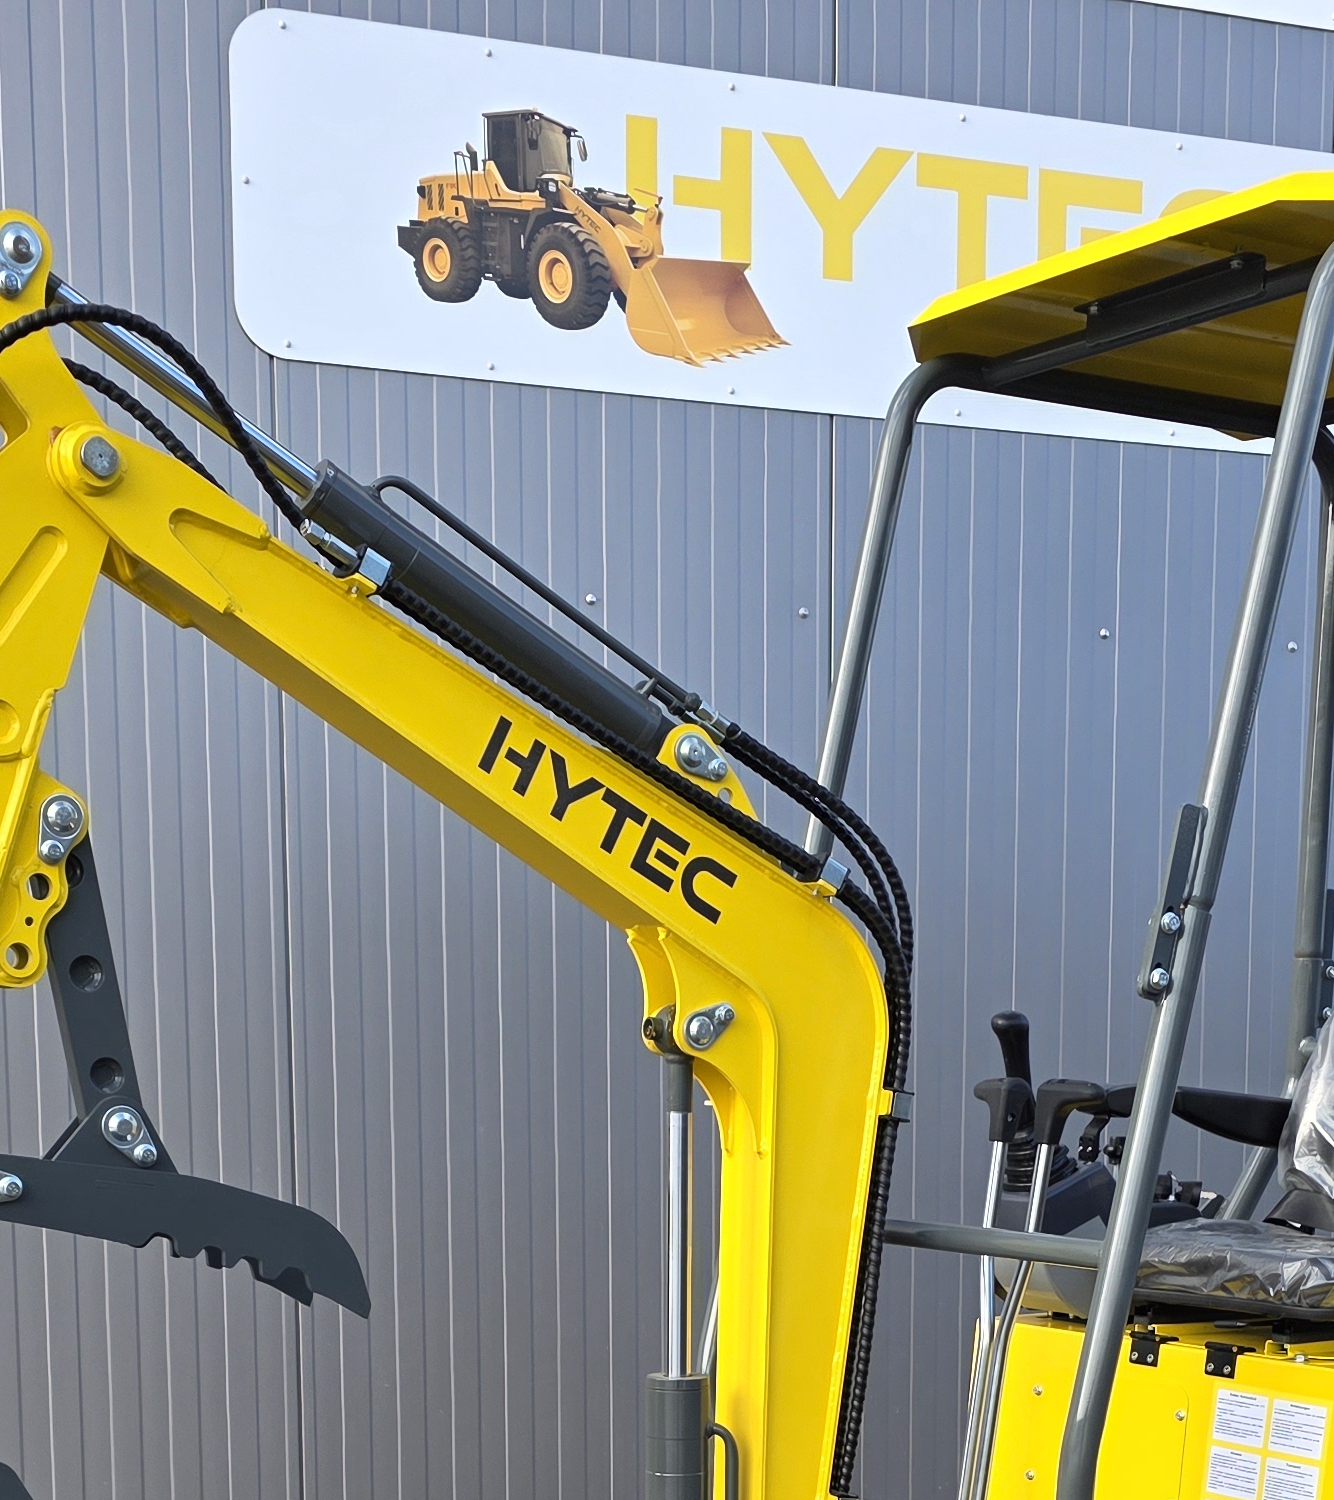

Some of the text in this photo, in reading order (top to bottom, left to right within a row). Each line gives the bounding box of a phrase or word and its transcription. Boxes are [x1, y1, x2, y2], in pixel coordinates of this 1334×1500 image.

[574, 205, 602, 234] HYTEC
[625, 114, 1236, 292] HYTE
[477, 714, 738, 925] HYTEC
